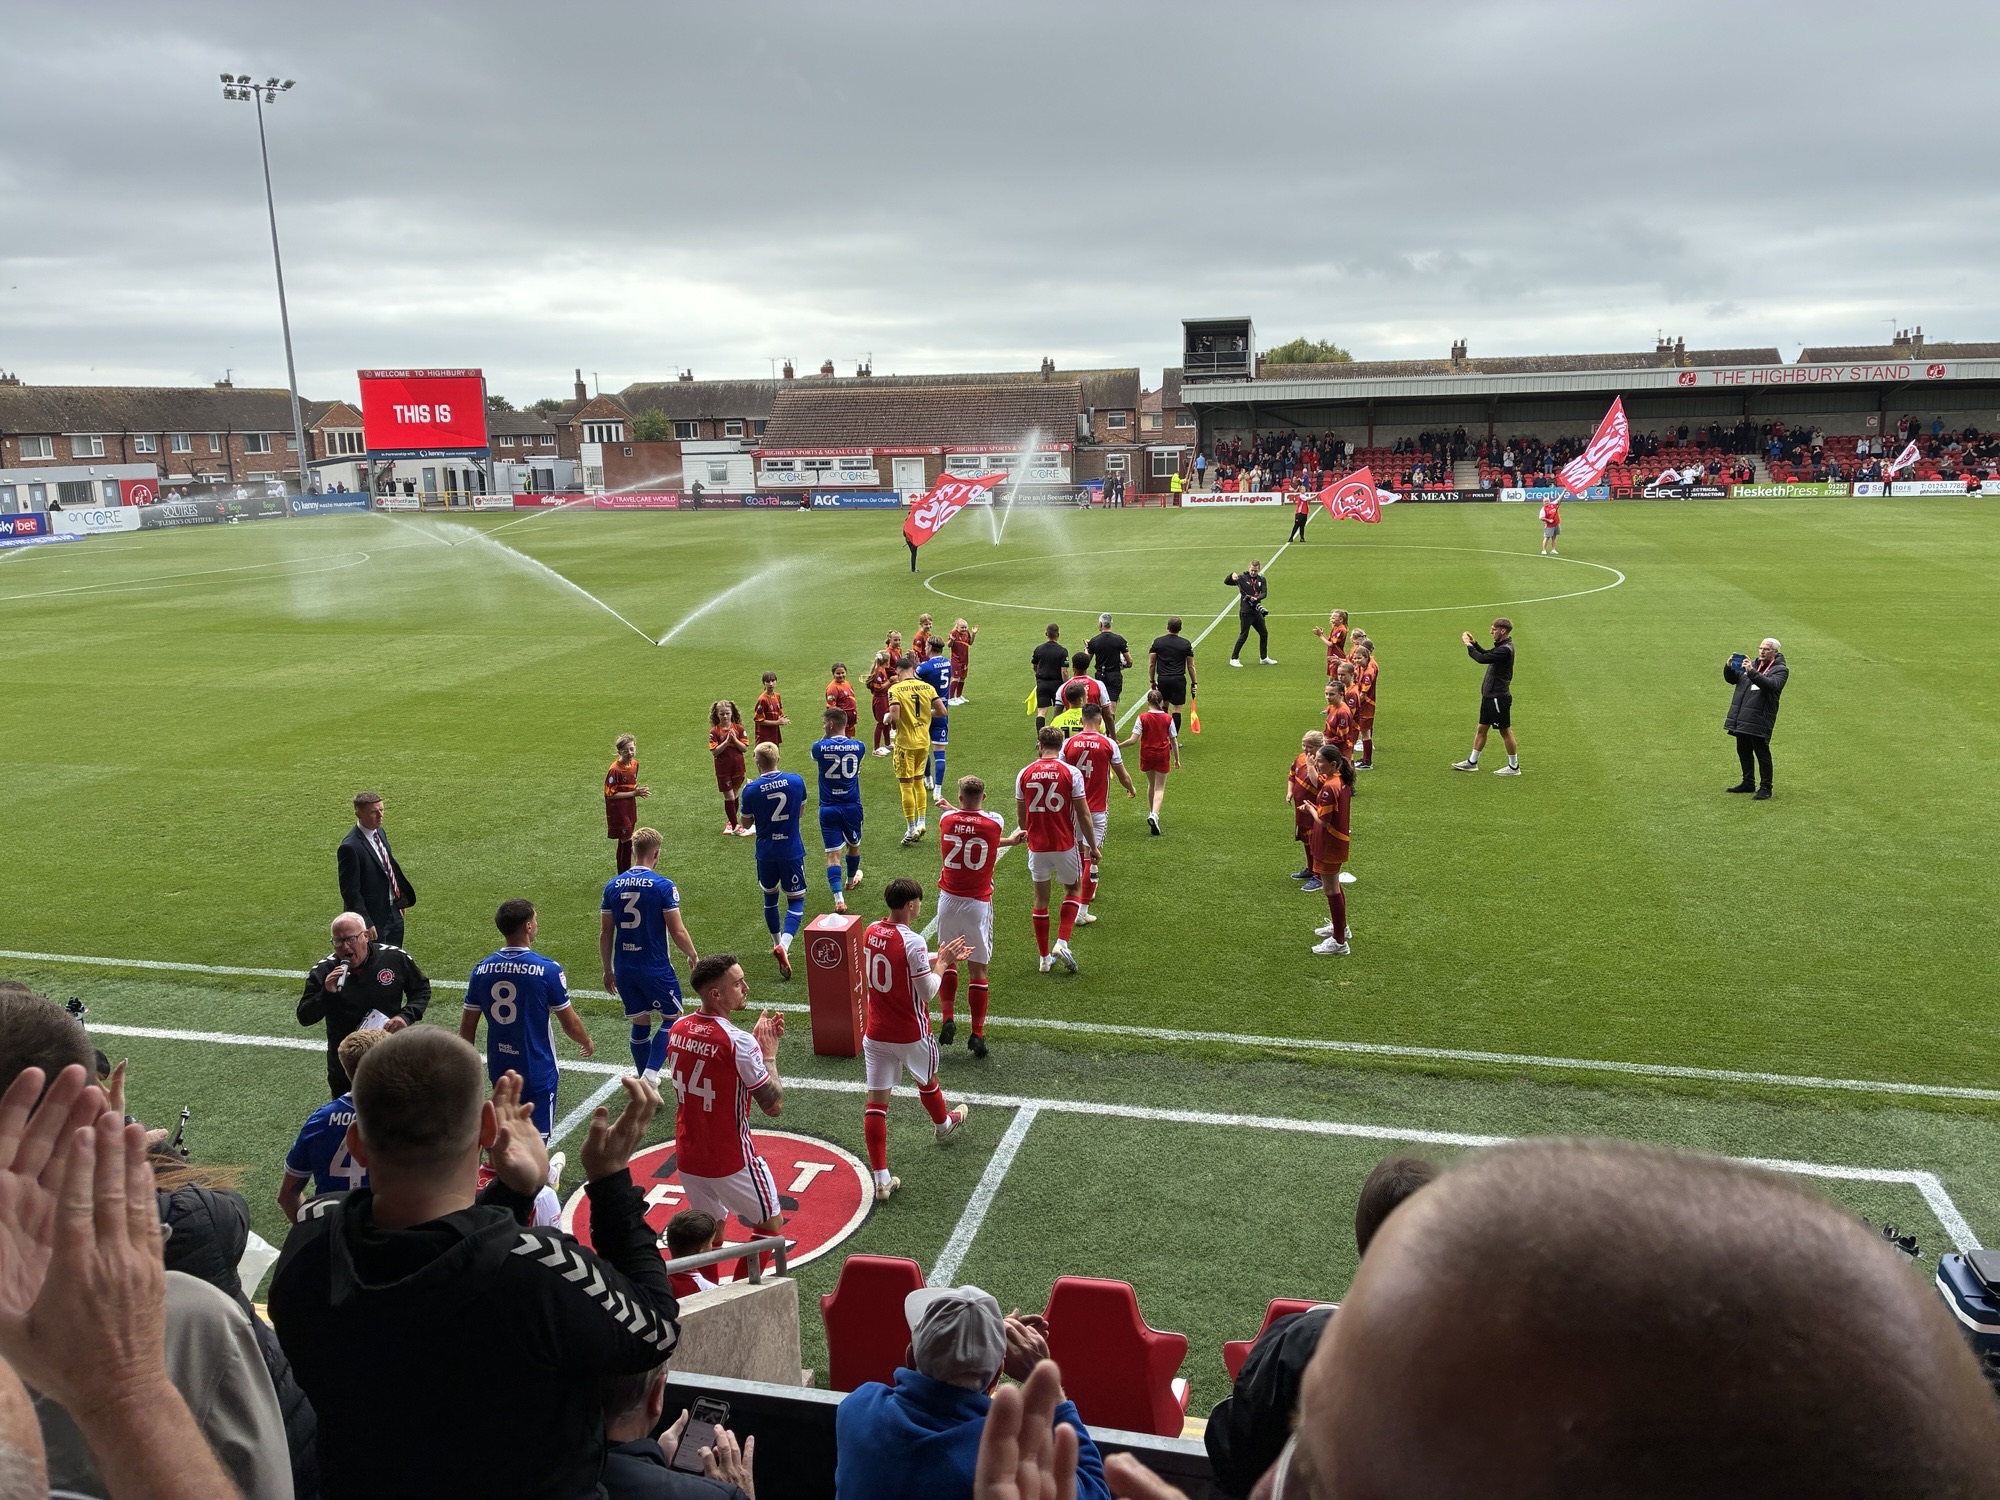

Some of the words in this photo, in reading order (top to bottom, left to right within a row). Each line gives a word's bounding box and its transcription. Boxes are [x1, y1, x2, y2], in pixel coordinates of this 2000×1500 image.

[1712, 370, 1746, 384] THE
[1752, 367, 1845, 384] HIGHBURY
[1850, 365, 1910, 380] STAND
[392, 404, 431, 424] THIS
[434, 404, 452, 422] IS
[1867, 416, 1877, 426] C
[1421, 492, 1459, 500] MEATS
[1526, 490, 1571, 499] creative
[1733, 485, 1818, 497] HeskethPress
[301, 501, 319, 510] kenny
[334, 500, 366, 508] management
[540, 496, 566, 506] Kellogg's
[745, 496, 780, 505] Coastal
[814, 495, 840, 506] AGC
[1225, 495, 1273, 503] Errington
[162, 504, 198, 517] SQUIRES
[17, 521, 36, 530] bet
[940, 669, 949, 689] 5
[911, 694, 920, 717] 1
[1073, 740, 1100, 749] BOLTON
[824, 753, 858, 779] 20
[1076, 750, 1094, 778] 4
[1031, 771, 1060, 780] ROONEY
[760, 779, 789, 792] SENIOR
[1026, 781, 1065, 813] 26
[766, 792, 790, 822] 2
[954, 824, 976, 834] NEAL
[943, 834, 989, 871] 20
[615, 877, 654, 888] SPARKES
[620, 892, 641, 929] 3
[868, 934, 887, 950] HELM
[476, 962, 544, 976] HUTCHINSON
[863, 946, 893, 993] 10
[490, 980, 517, 1025] 8
[669, 1033, 719, 1058] MULLARKEY
[669, 1051, 716, 1112] 44
[329, 1134, 367, 1190] 4
